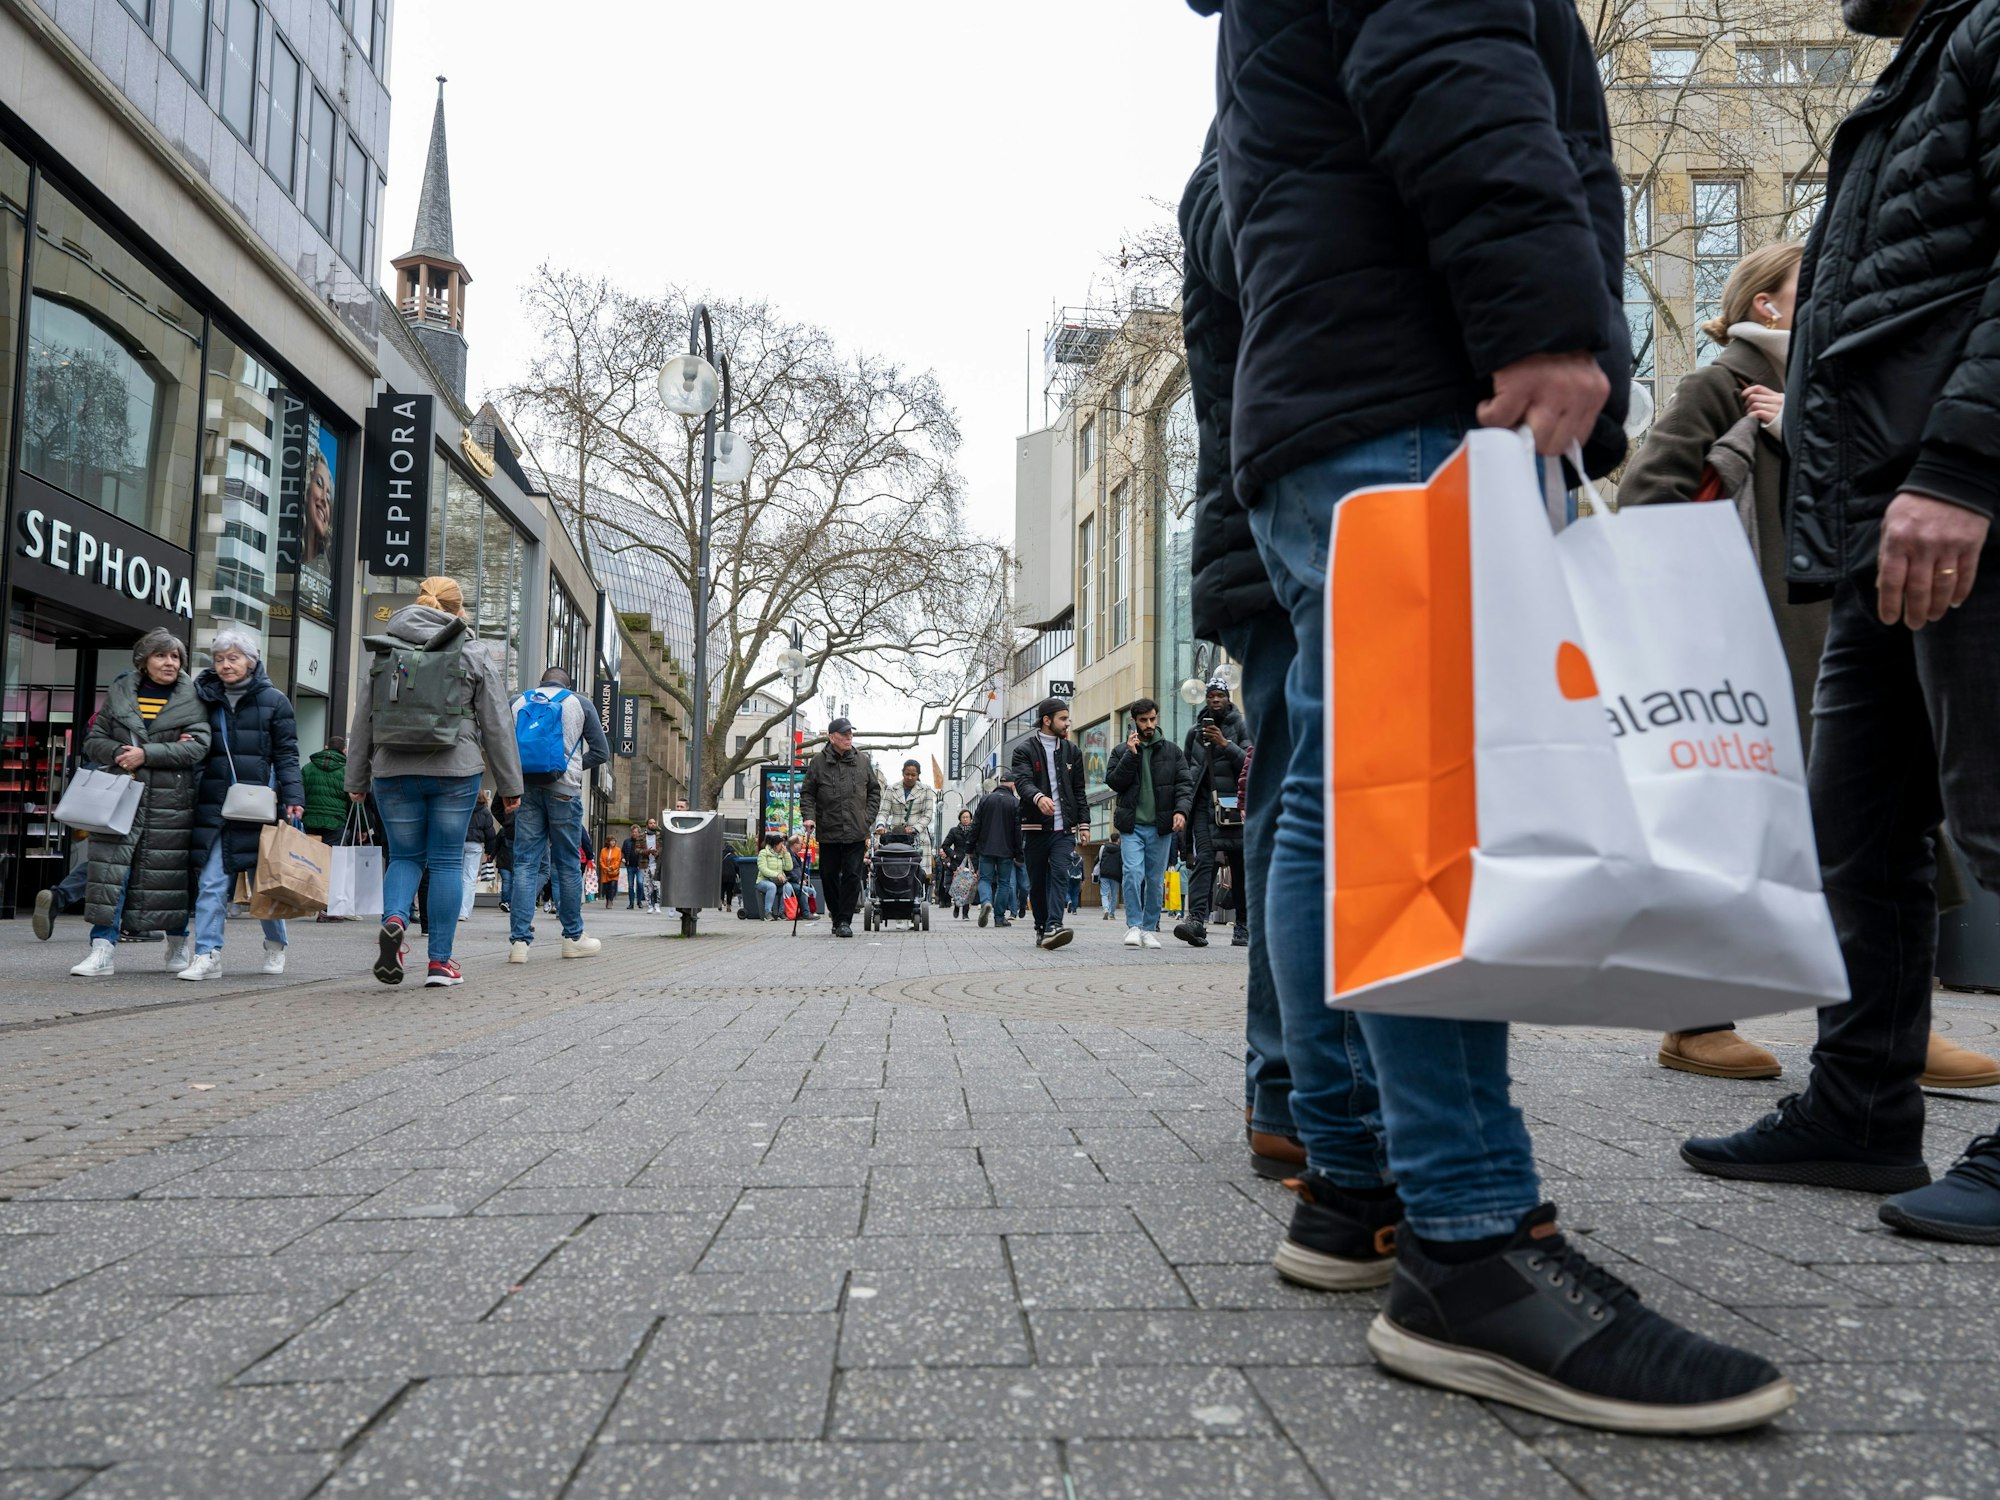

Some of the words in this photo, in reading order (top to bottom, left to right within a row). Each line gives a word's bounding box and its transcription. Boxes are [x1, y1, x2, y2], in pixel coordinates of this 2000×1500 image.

[385, 400, 417, 568] SEPHORA
[25, 509, 193, 619] SEPHORA
[309, 659, 318, 676] 49
[602, 684, 611, 705] KLEIN
[1052, 683, 1071, 694] C&A
[601, 706, 610, 734] CALVIN
[625, 699, 634, 715] SPEX
[1604, 678, 1769, 737] alando
[624, 715, 633, 738] MISTER
[952, 719, 960, 754] SUPERDRY
[1669, 732, 1779, 775] outlet
